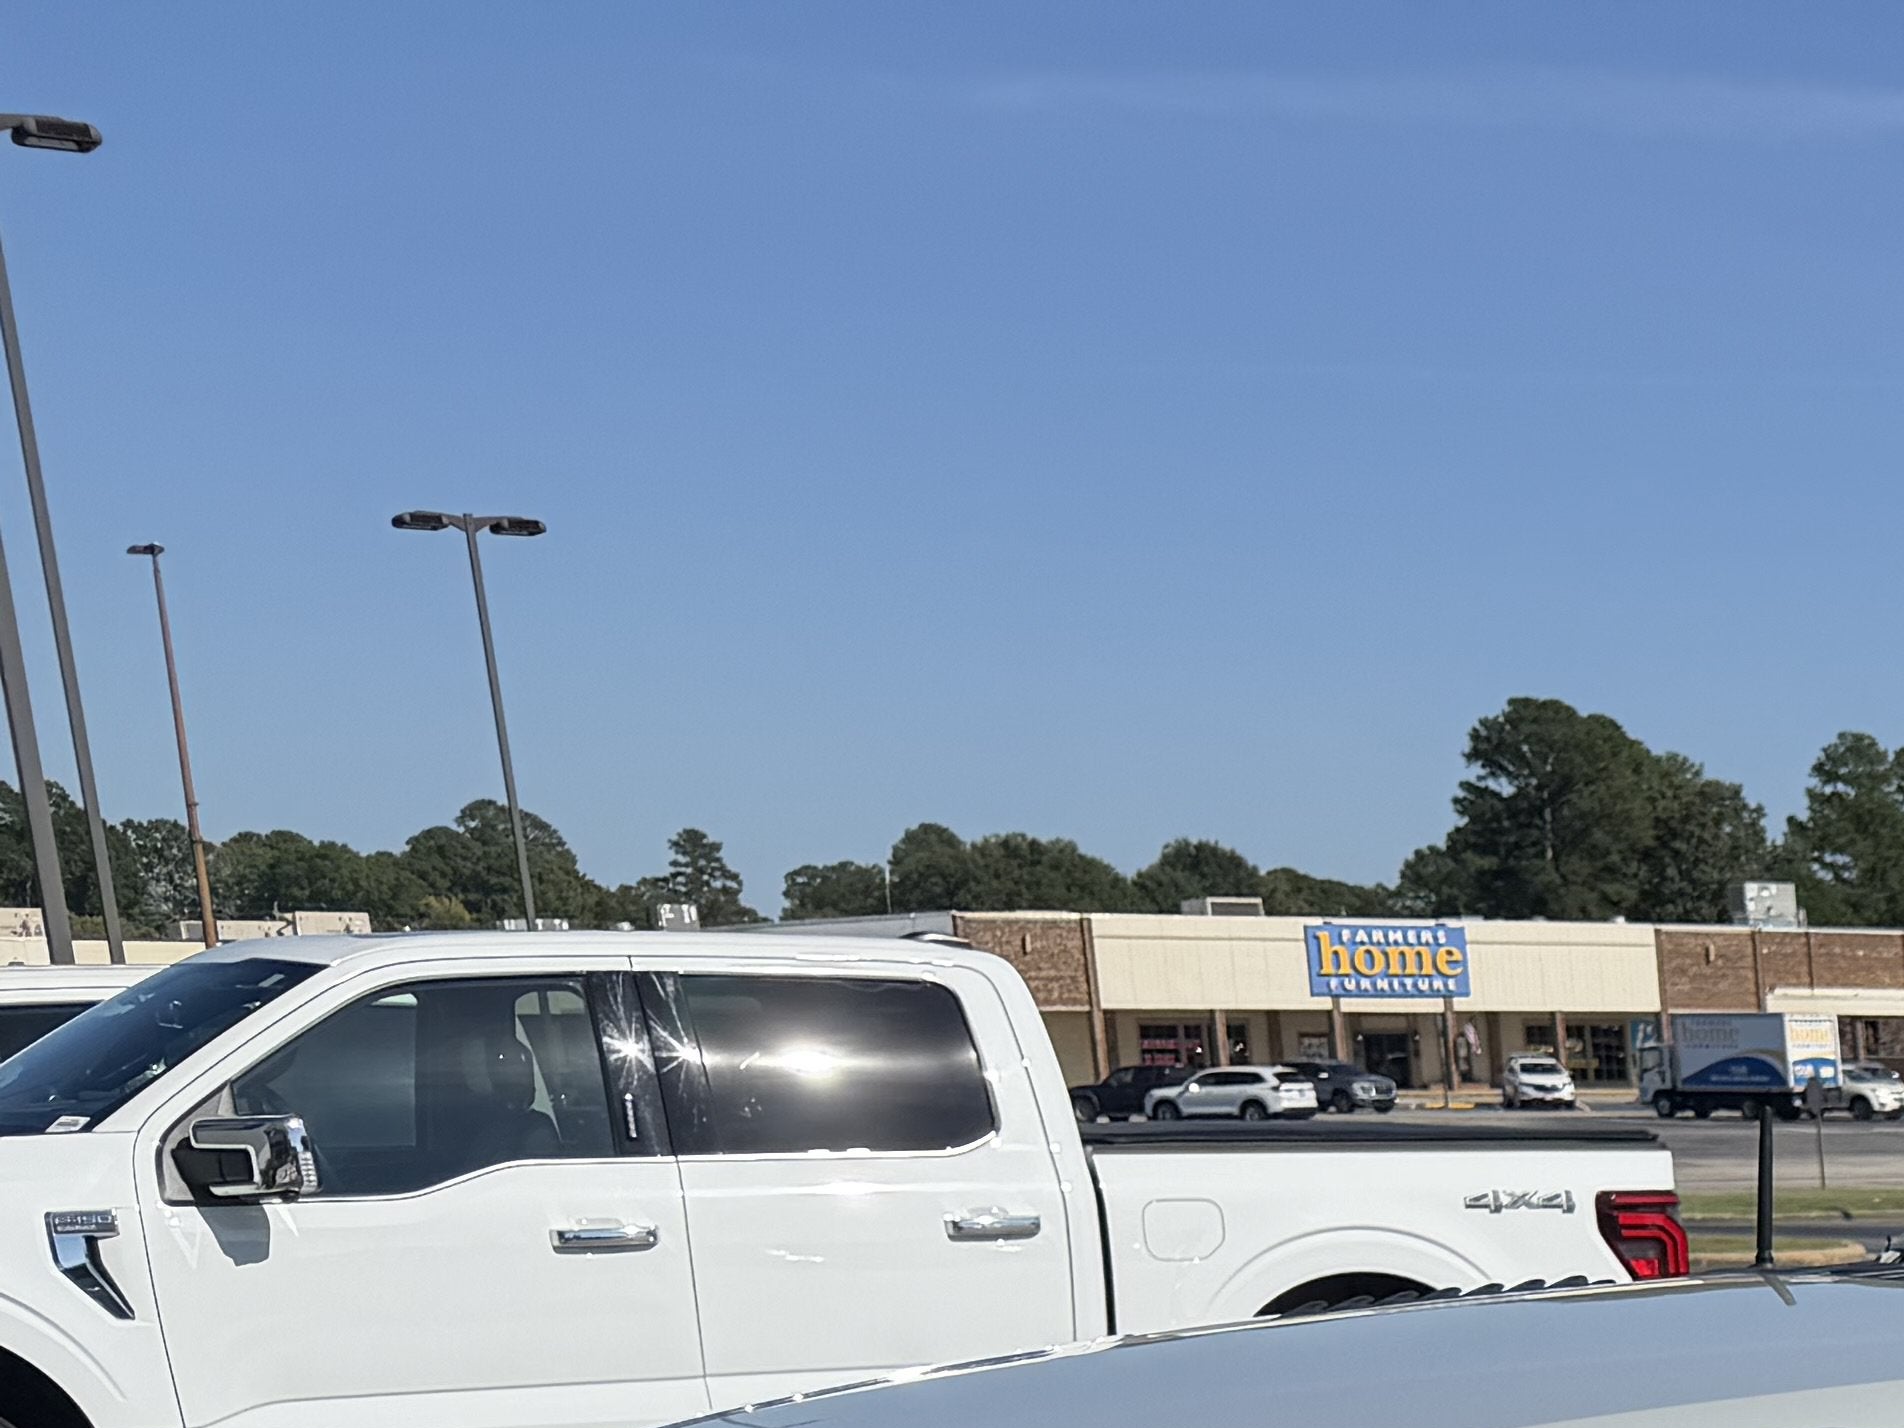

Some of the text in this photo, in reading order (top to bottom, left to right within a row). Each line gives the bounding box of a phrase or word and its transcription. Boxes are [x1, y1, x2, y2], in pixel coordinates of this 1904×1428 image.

[1341, 928, 1446, 944] FARMERS
[1316, 931, 1464, 975] home
[1329, 977, 1457, 992] FURNITURE
